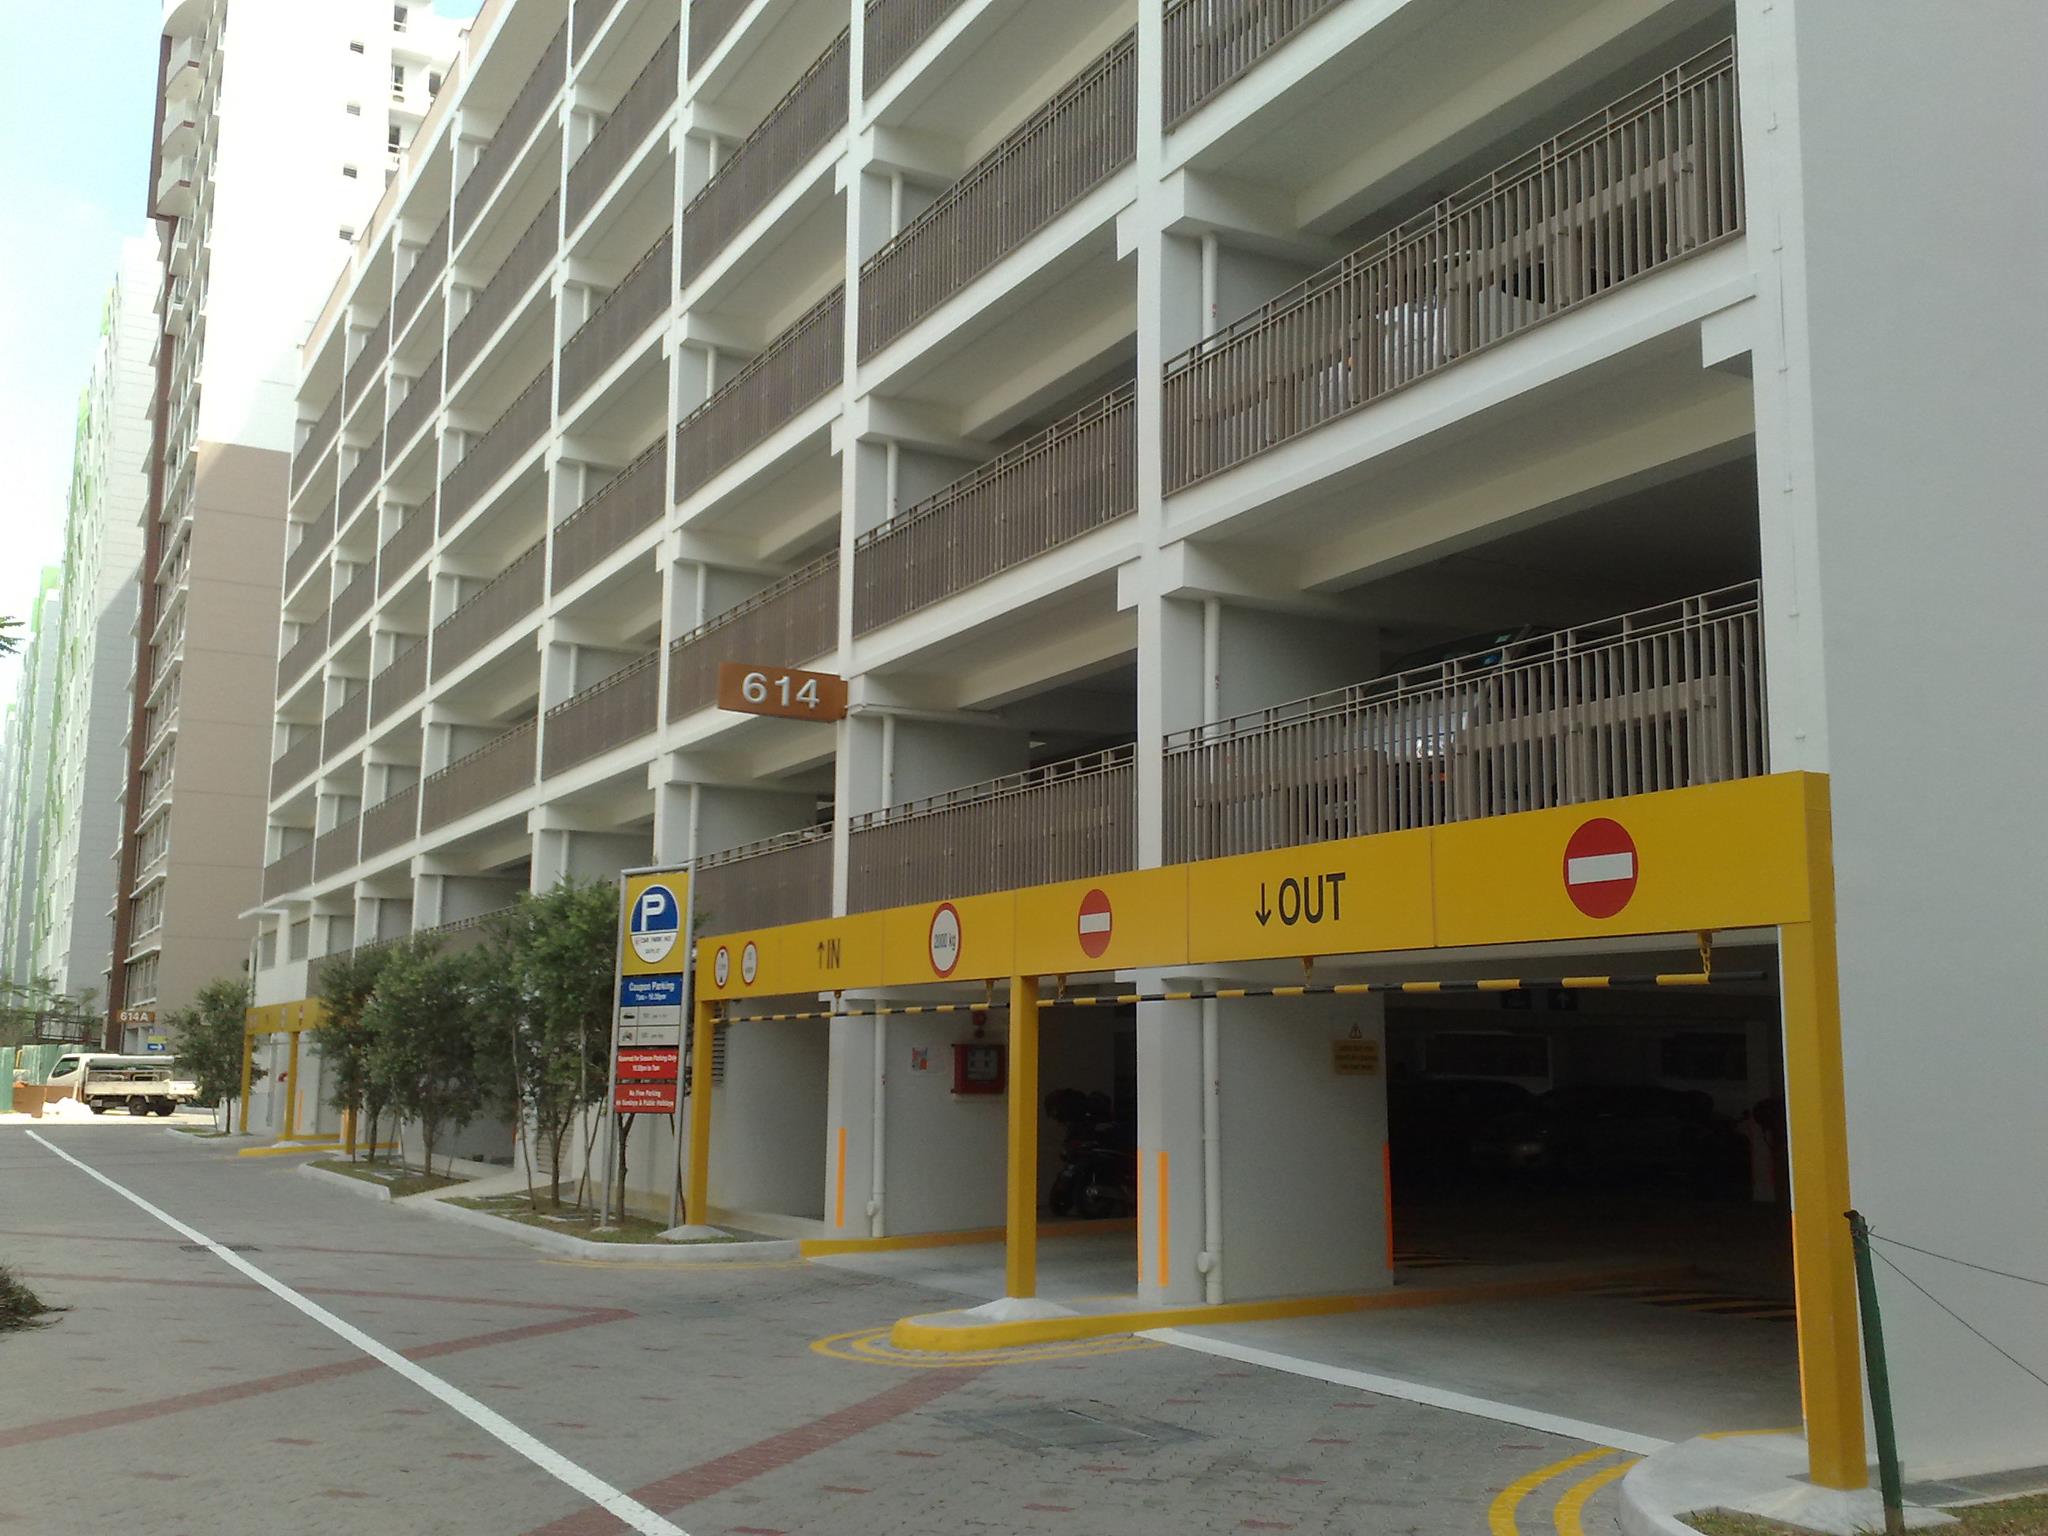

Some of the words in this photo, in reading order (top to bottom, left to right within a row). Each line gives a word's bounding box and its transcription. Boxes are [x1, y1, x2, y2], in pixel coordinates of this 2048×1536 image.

[742, 671, 820, 709] 614
[1278, 872, 1346, 926] OUT
[641, 894, 665, 931] P
[934, 932, 948, 949] 2000
[948, 932, 957, 951] kg
[826, 938, 841, 970] IN
[629, 982, 651, 993] Coupon
[651, 981, 675, 992] Parking
[120, 1011, 149, 1022] 614A
[654, 1055, 667, 1063] Parking
[668, 1054, 677, 1063] Only
[645, 1090, 661, 1098] Parking
